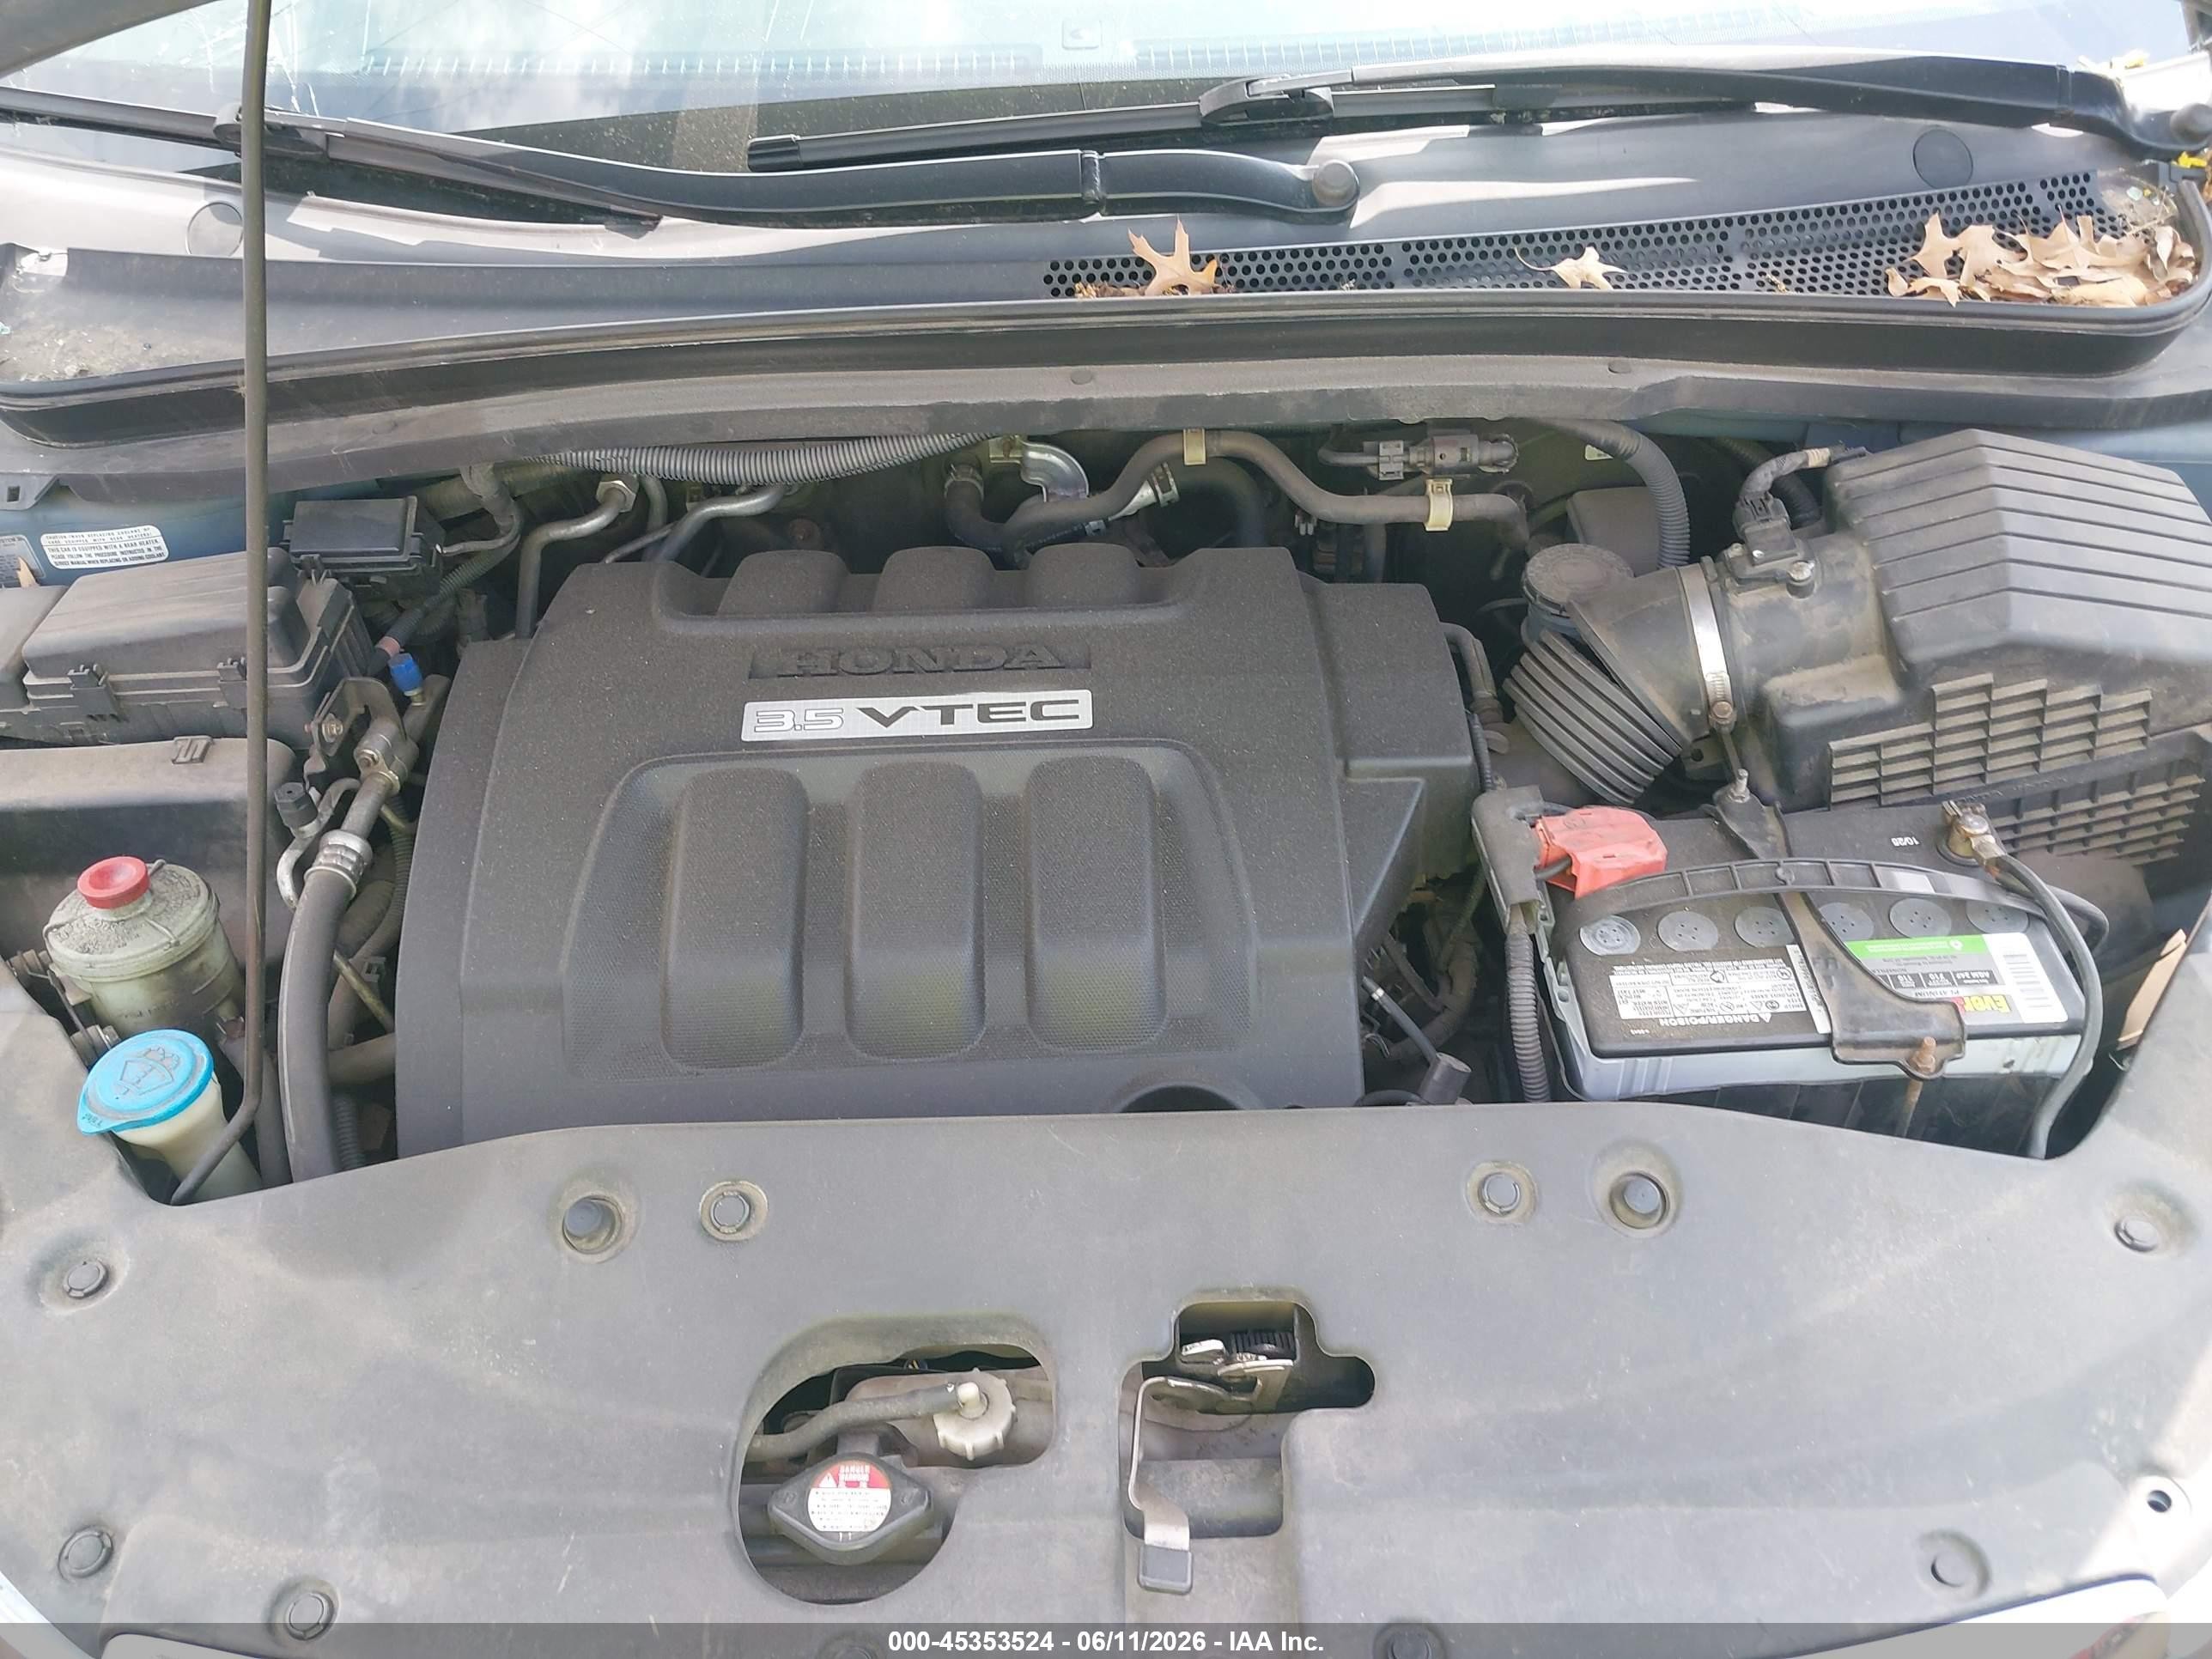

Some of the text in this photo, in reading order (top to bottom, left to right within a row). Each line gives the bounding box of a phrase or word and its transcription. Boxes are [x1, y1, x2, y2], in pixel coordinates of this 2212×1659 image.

[777, 645, 1066, 677] HONDA
[754, 698, 1080, 733] 3.5 VTEC
[1913, 989, 1960, 999] PLATINUM
